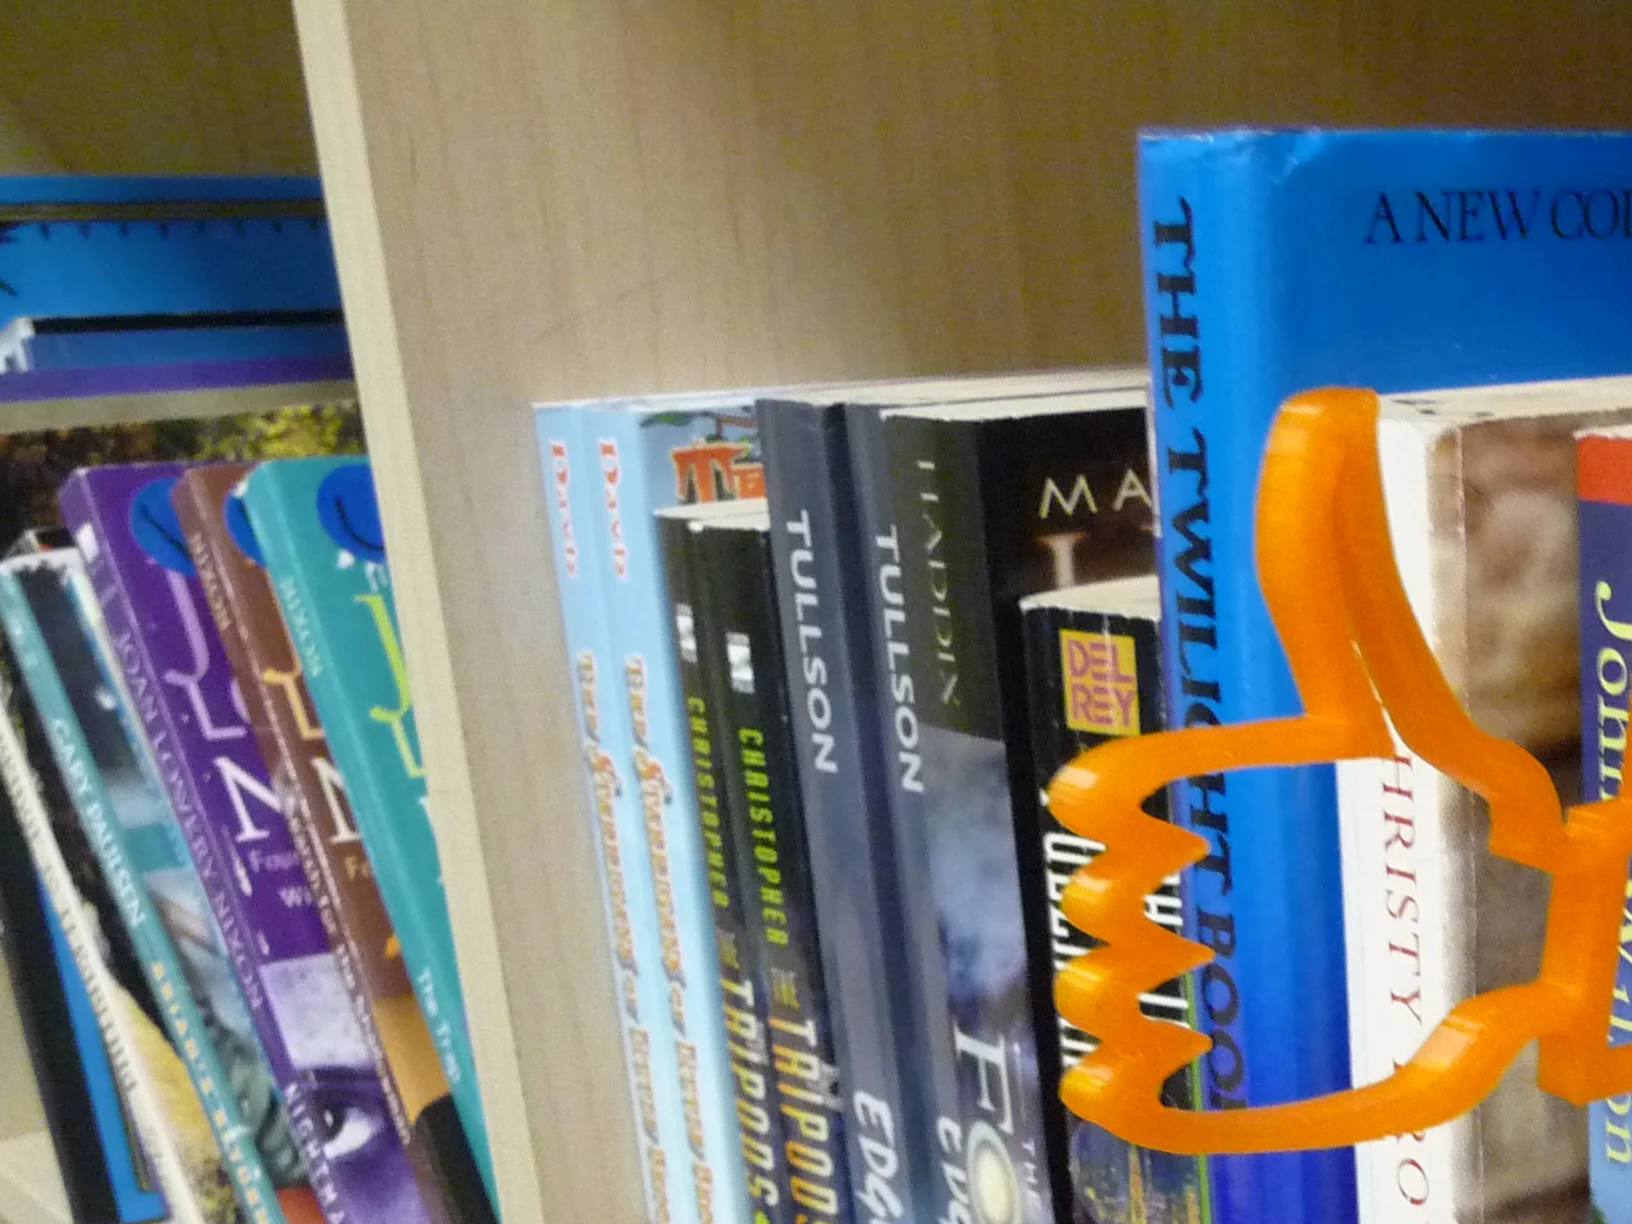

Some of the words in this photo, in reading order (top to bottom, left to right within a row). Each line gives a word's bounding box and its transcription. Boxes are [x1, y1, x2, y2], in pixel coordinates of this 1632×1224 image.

[1366, 192, 1401, 244] A
[1414, 189, 1541, 243] NEW
[277, 577, 325, 680] NIXON
[787, 508, 838, 775] TULLSON
[875, 524, 925, 793] TULLSON
[1067, 638, 1135, 686] DEL
[1071, 683, 1139, 728] REY
[1153, 196, 1204, 410] THE
[1196, 904, 1250, 1108] BOO
[50, 715, 95, 797] GARY
[82, 799, 147, 929] PAULSEN
[112, 631, 160, 728] JOAN
[212, 889, 265, 1011] NIXON
[686, 697, 730, 908] CHRISTOPHER
[738, 727, 789, 947] CHRISTOPHER
[1380, 756, 1424, 1025] HRISTY
[719, 980, 780, 1207] TRIPODS
